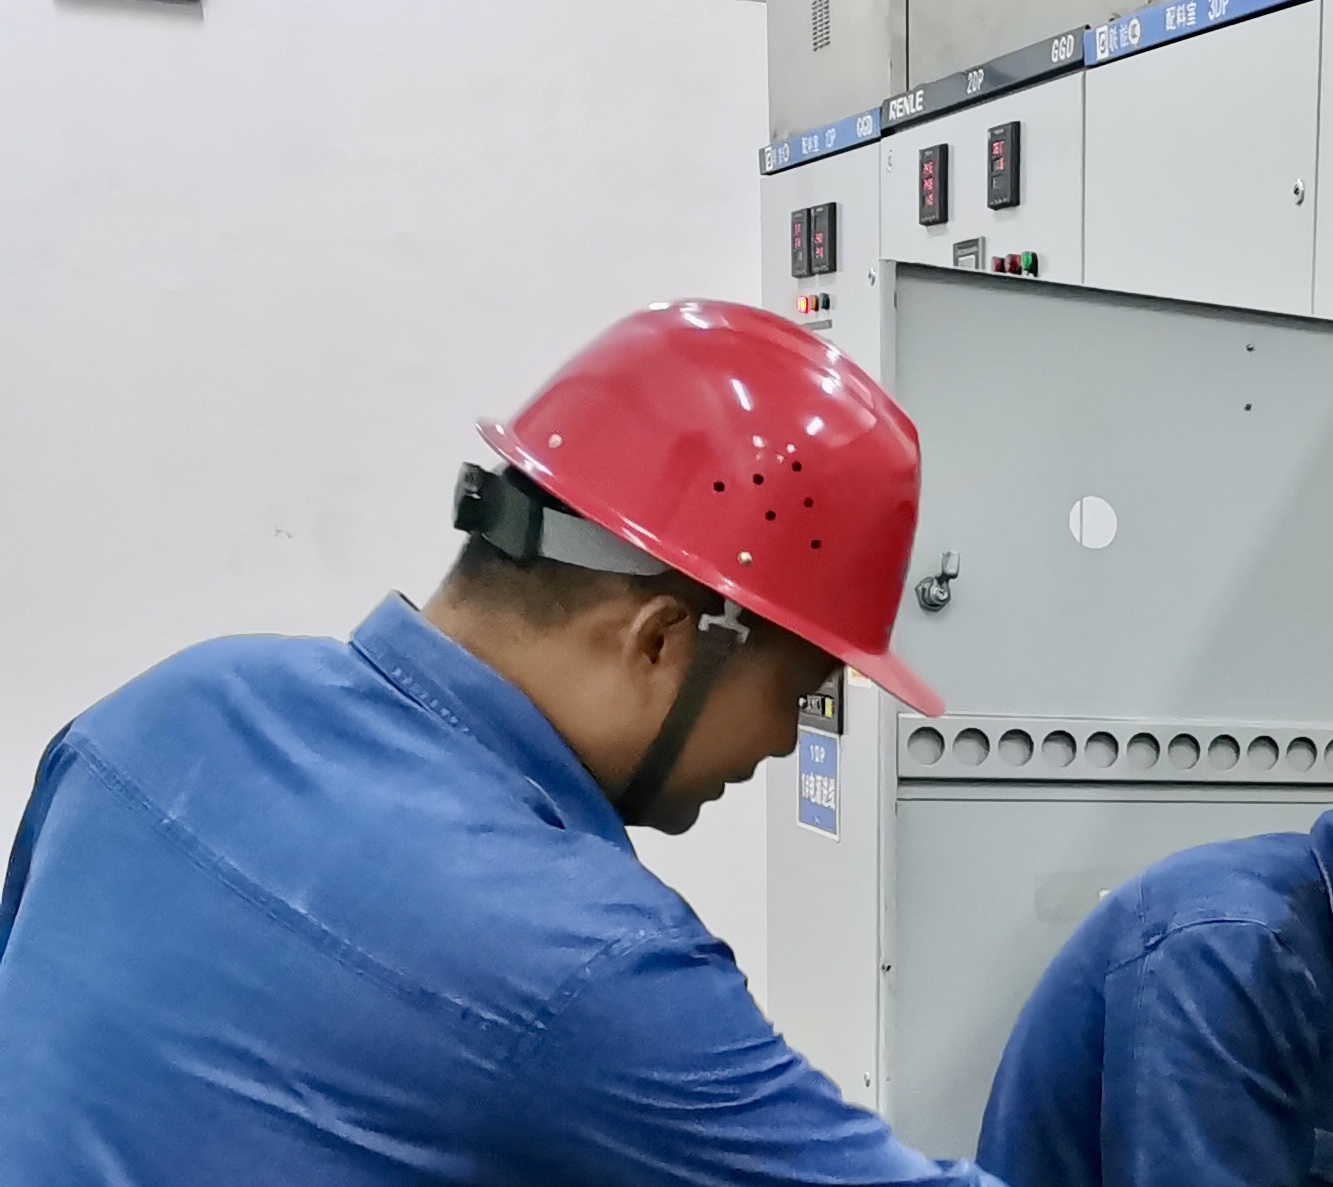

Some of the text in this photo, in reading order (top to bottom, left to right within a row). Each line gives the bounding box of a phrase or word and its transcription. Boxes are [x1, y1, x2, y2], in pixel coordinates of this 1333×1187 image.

[889, 34, 1075, 121] RENLE 2DP GGD
